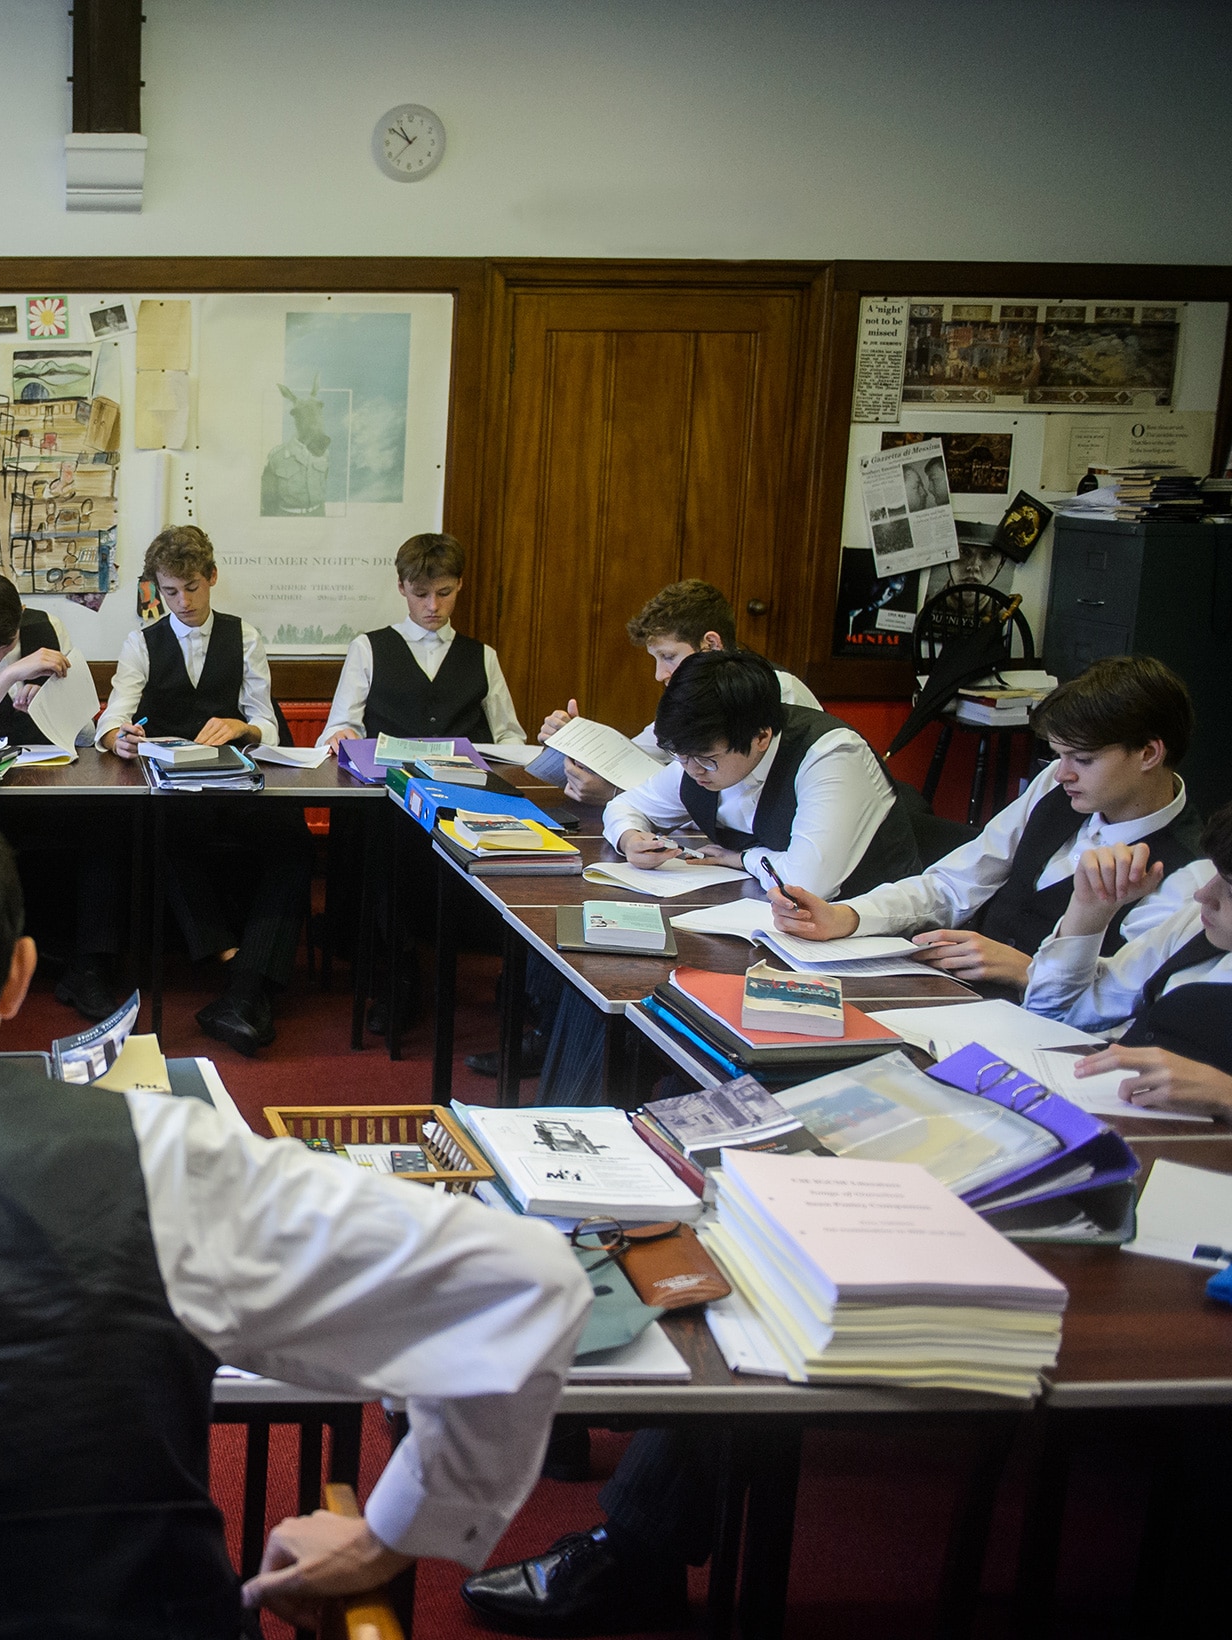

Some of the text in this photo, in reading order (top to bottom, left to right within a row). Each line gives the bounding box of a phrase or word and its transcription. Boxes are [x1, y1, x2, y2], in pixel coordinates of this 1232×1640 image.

[868, 328, 898, 337] missed
[1131, 423, 1145, 438] O
[903, 448, 911, 457] di
[222, 556, 308, 566] MIDSUMMER
[312, 556, 368, 566] NIGHT'S
